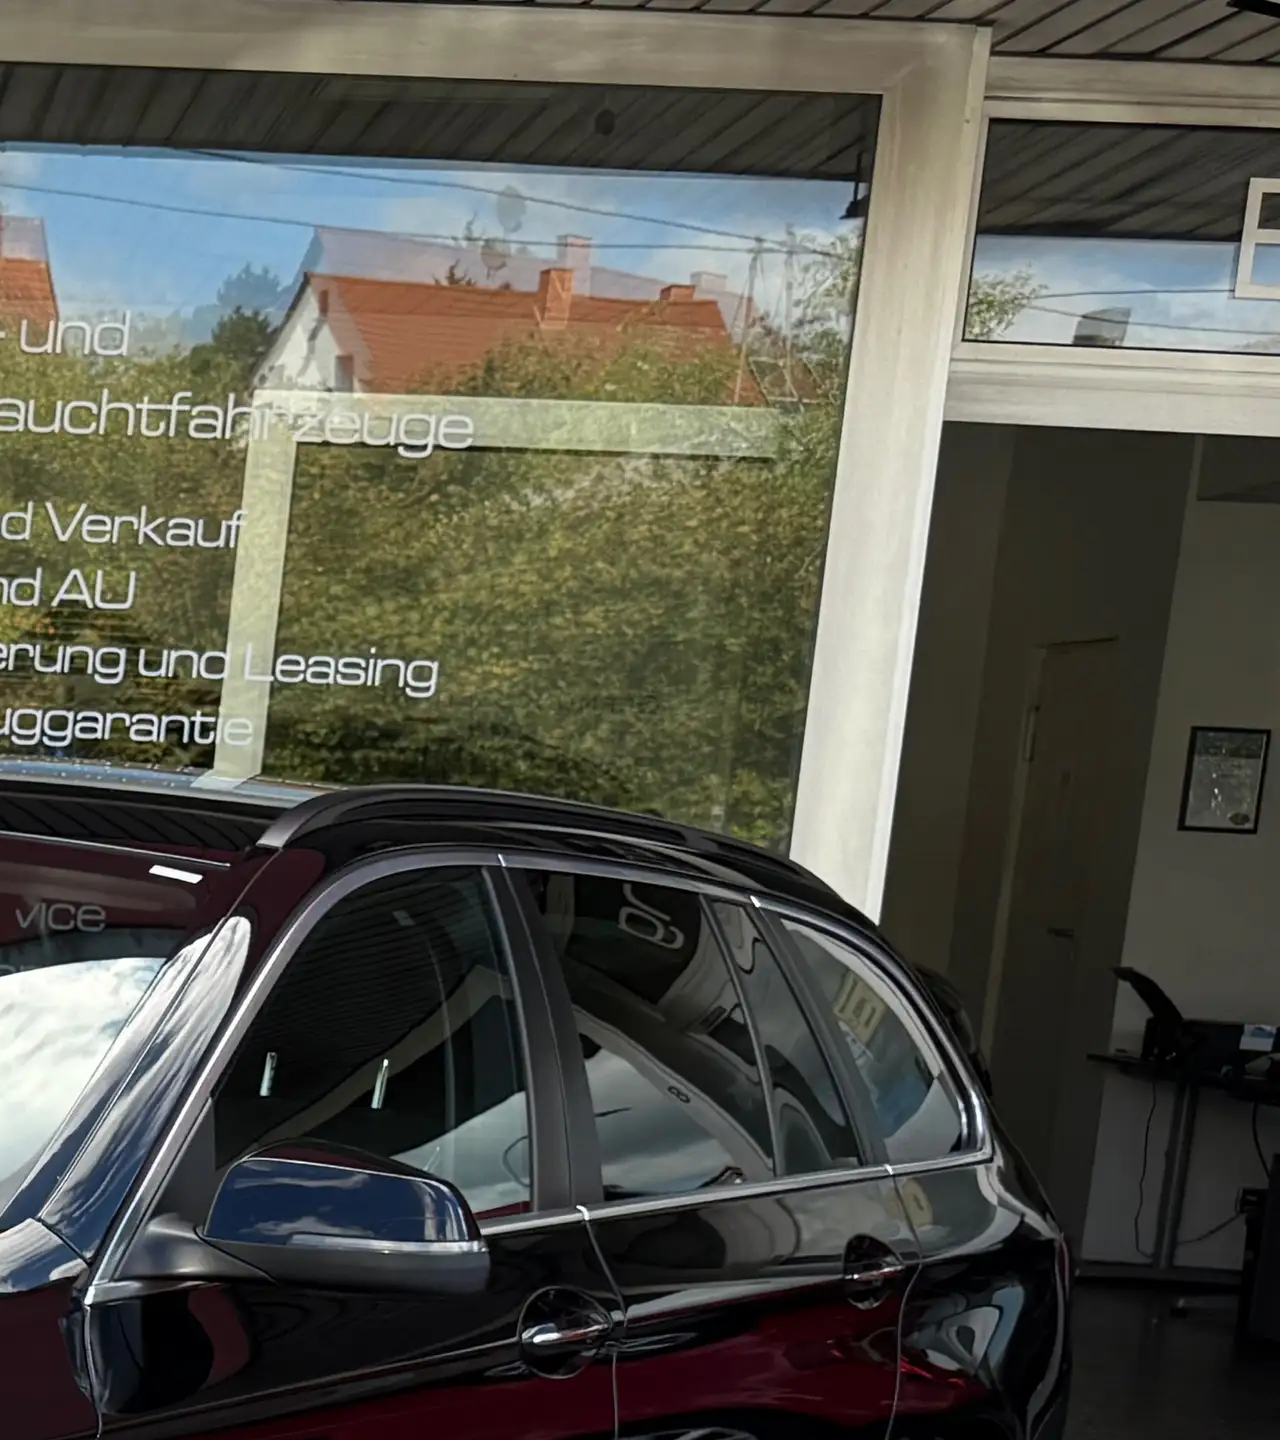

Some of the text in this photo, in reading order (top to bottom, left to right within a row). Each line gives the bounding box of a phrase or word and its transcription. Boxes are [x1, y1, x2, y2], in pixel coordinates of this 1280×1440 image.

[19, 308, 131, 357] und
[44, 502, 249, 549] Verkauf
[51, 568, 138, 611] AU
[138, 643, 234, 681] und
[243, 642, 440, 699] Leasing
